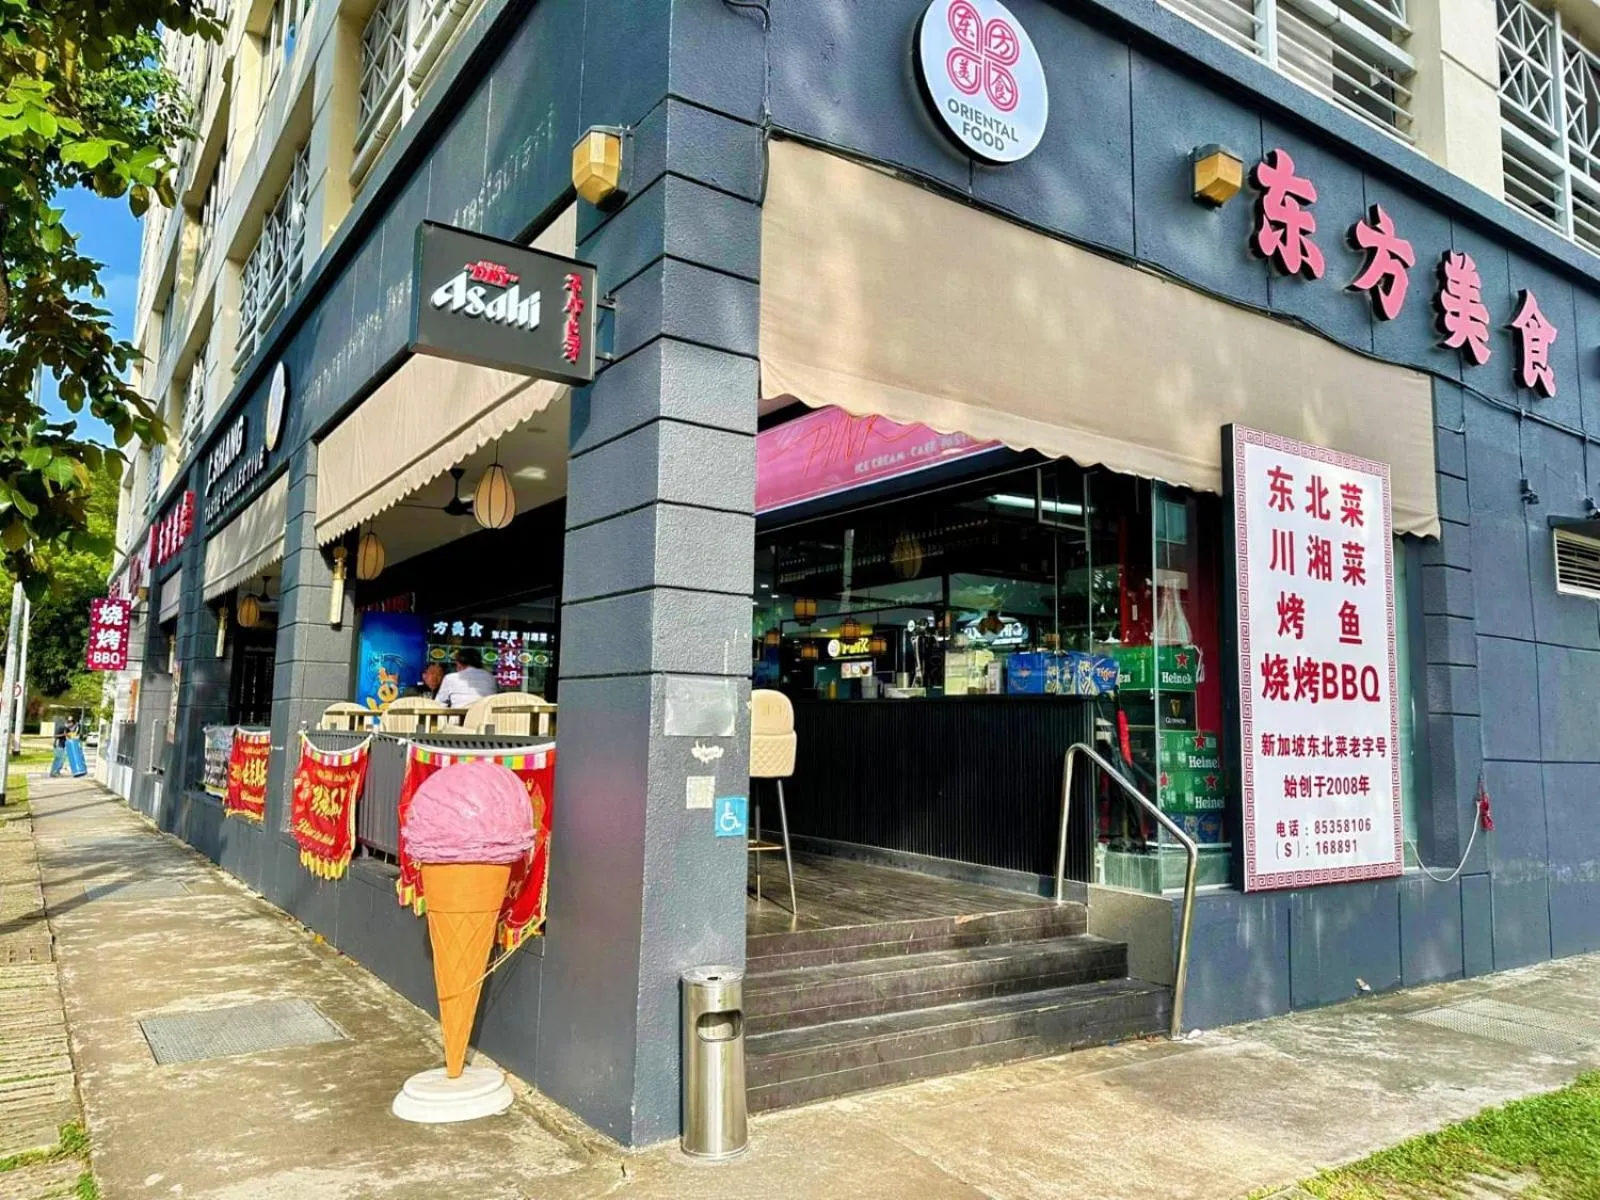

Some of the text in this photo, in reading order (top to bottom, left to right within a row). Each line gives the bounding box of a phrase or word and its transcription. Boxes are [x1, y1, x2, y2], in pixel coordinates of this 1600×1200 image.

[948, 98, 1019, 142] ORIENTAL
[962, 122, 1005, 151] FOOD
[1252, 148, 1557, 398] 东方美食
[431, 271, 541, 330] Asahi
[1267, 465, 1364, 528] 东北菜
[1269, 529, 1366, 587] 川湘菜
[96, 603, 124, 651] 烧烤
[1277, 591, 1363, 645] 烤鱼
[92, 652, 121, 664] BBQ
[1261, 653, 1380, 704] 烧烤BBQ
[1261, 732, 1388, 758] 新加坡东北菜老字号
[1284, 774, 1371, 799] 始创于2008年
[1314, 818, 1371, 835] 85358106
[1315, 839, 1358, 856] 168891
